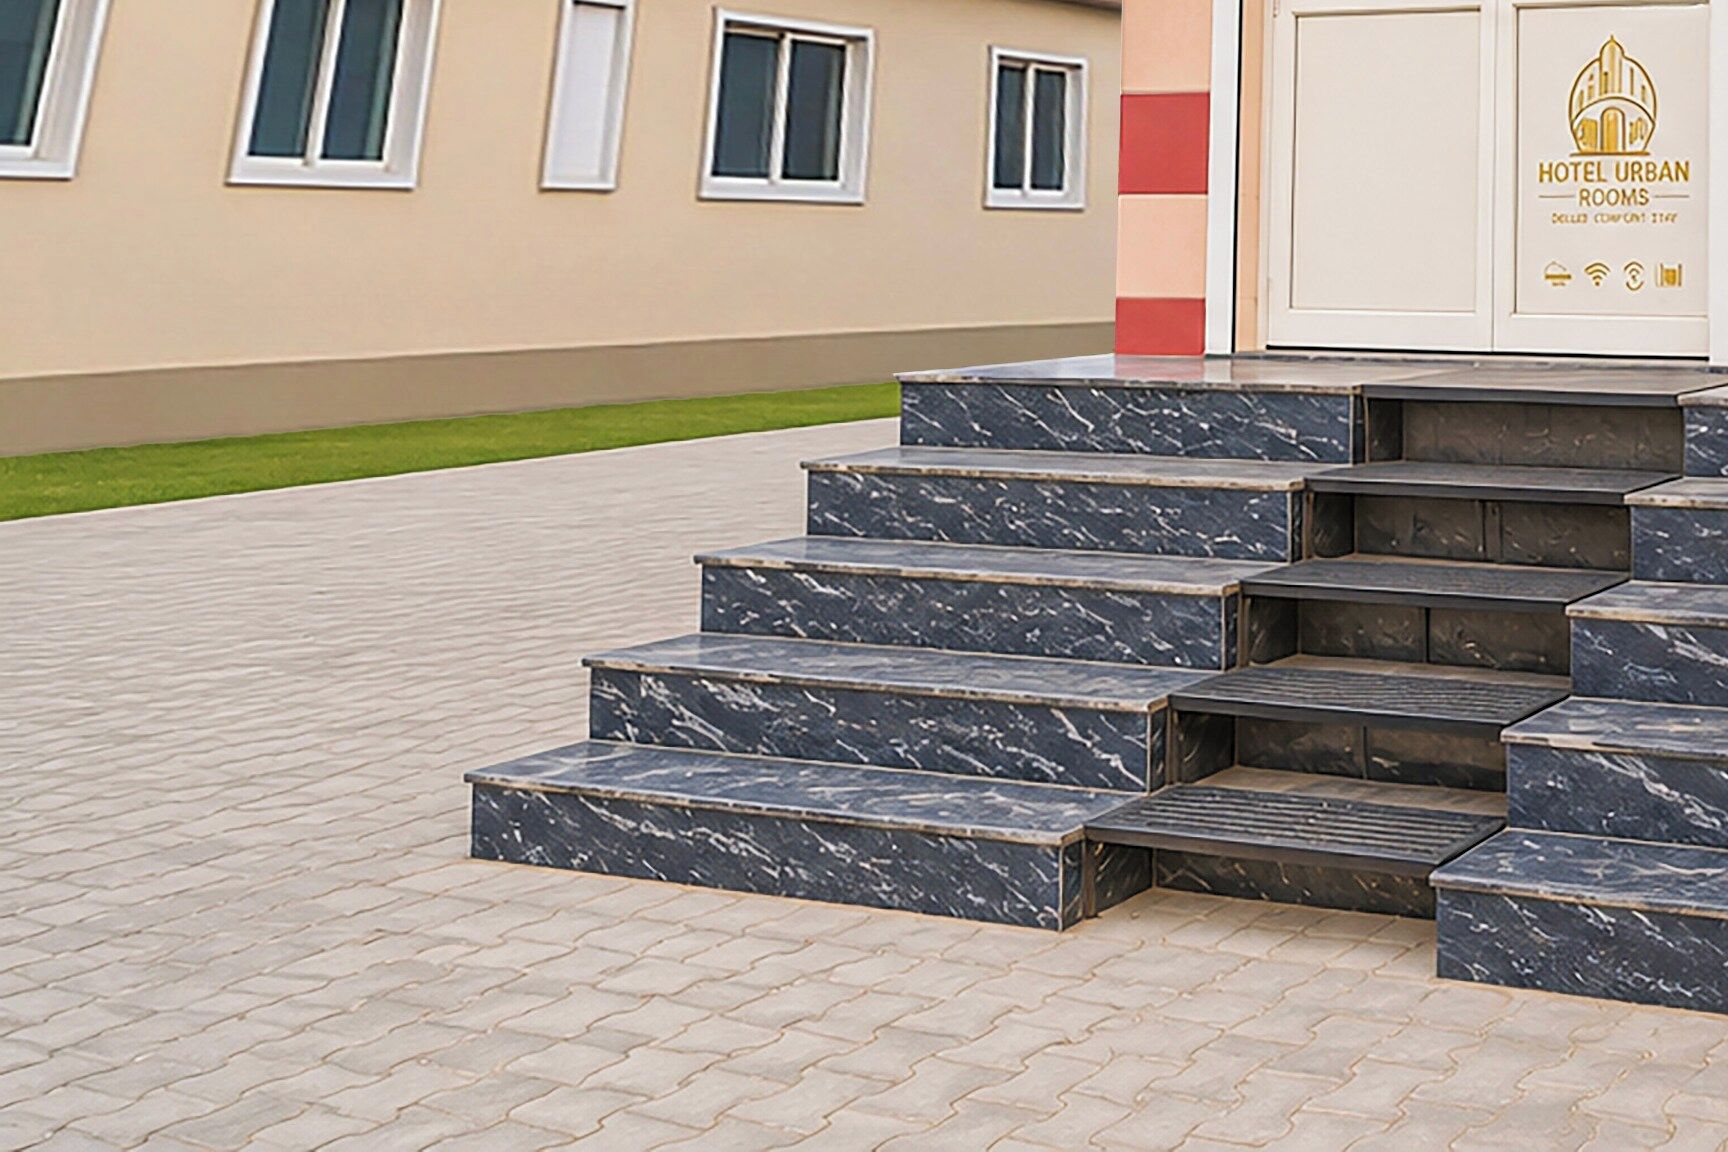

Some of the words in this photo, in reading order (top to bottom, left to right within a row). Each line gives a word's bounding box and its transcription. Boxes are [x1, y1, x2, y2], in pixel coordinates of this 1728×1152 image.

[1538, 160, 1608, 184] HOTEL
[1614, 160, 1690, 183] URBAN
[1578, 188, 1650, 207] ROOMS
